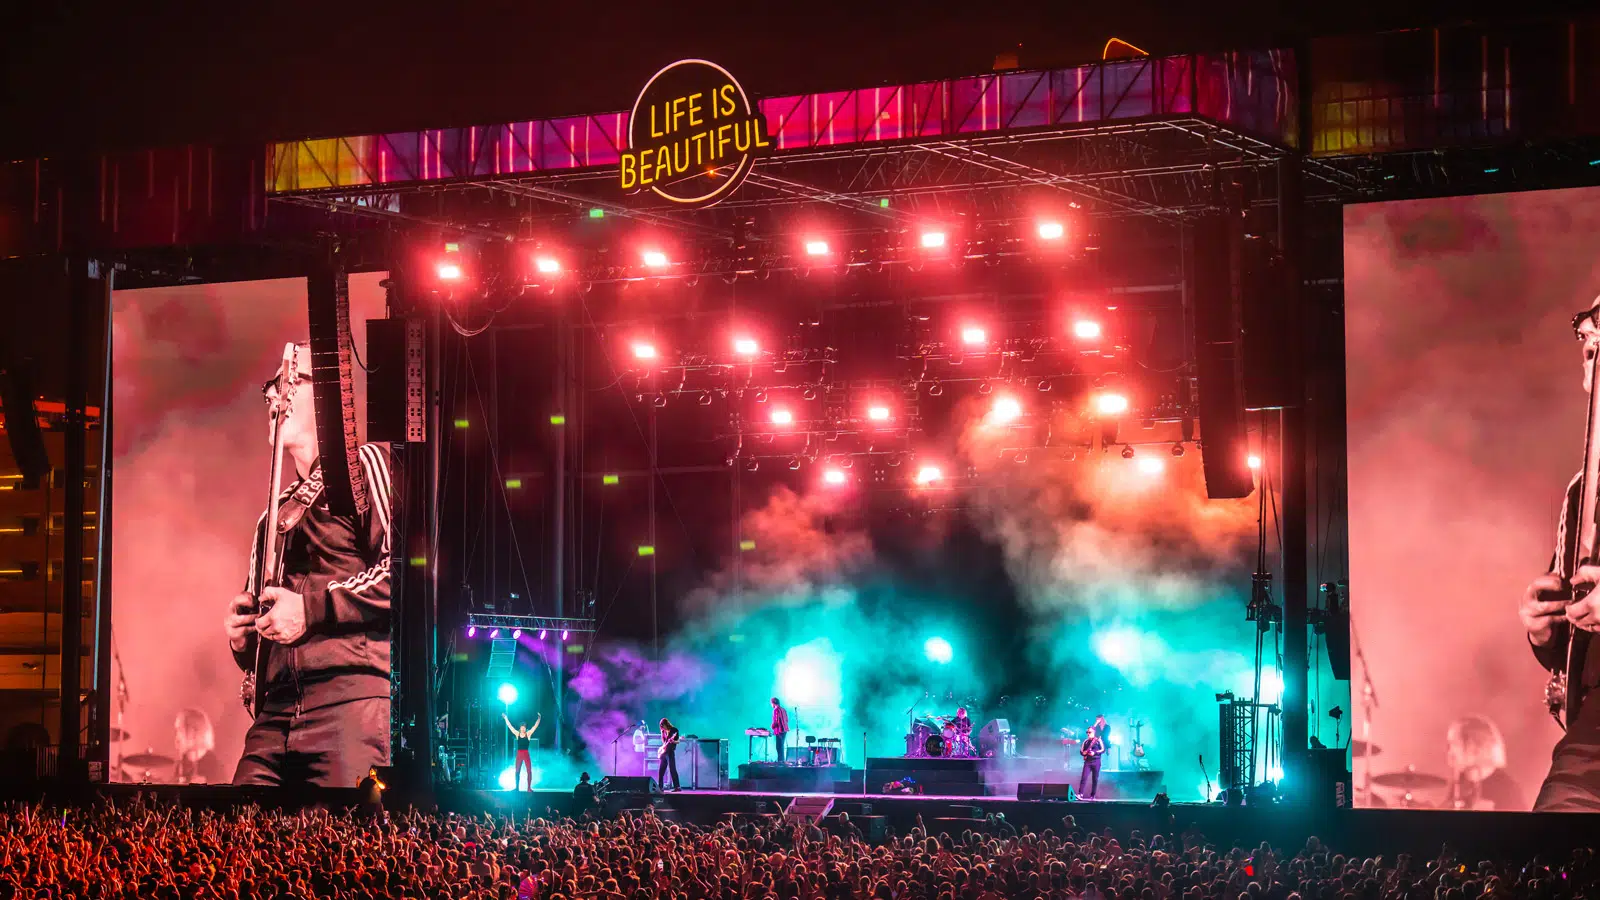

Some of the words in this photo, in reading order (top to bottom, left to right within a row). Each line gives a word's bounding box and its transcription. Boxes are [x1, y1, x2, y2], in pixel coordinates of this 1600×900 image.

[651, 92, 704, 138] LIFE
[712, 84, 736, 119] IS
[621, 118, 770, 189] BEAUTIFUL
